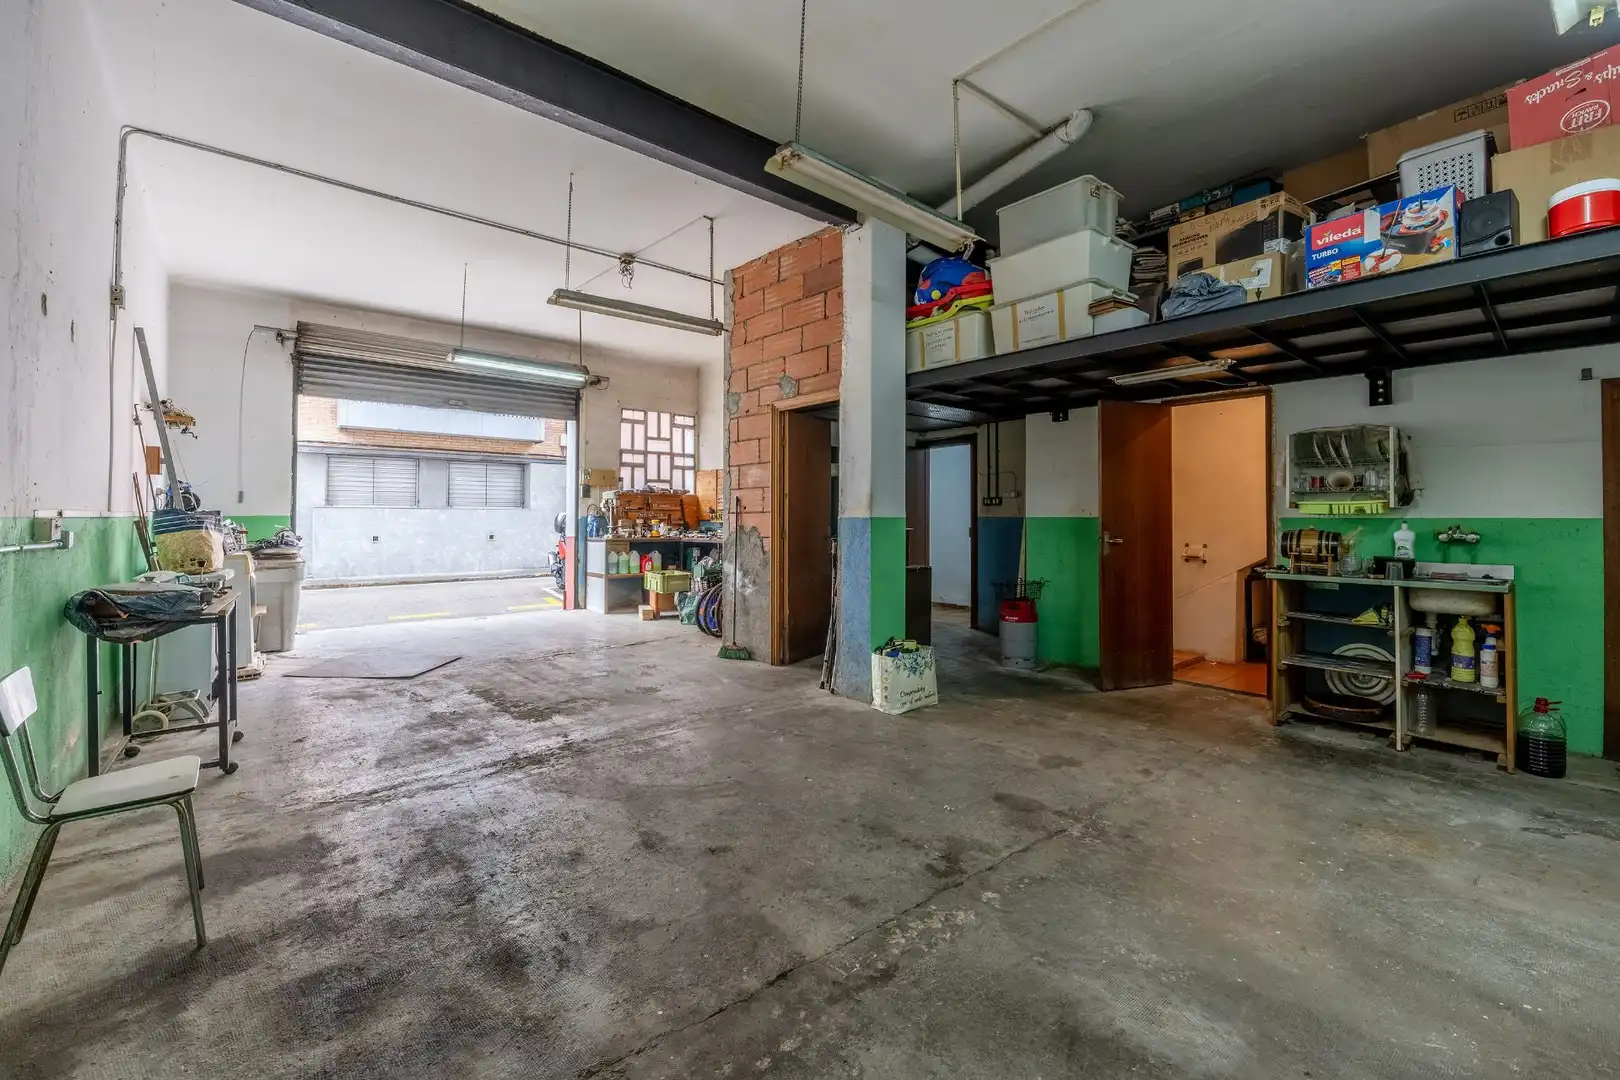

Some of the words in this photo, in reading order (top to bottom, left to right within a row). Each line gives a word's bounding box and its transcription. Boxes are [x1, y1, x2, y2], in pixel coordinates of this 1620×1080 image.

[1584, 71, 1593, 81] &
[1524, 70, 1583, 104] Snacks
[1568, 109, 1602, 129] FRIT
[1571, 104, 1599, 118] RAVICH
[1316, 227, 1361, 245] vileda
[1311, 247, 1339, 261] TURBO
